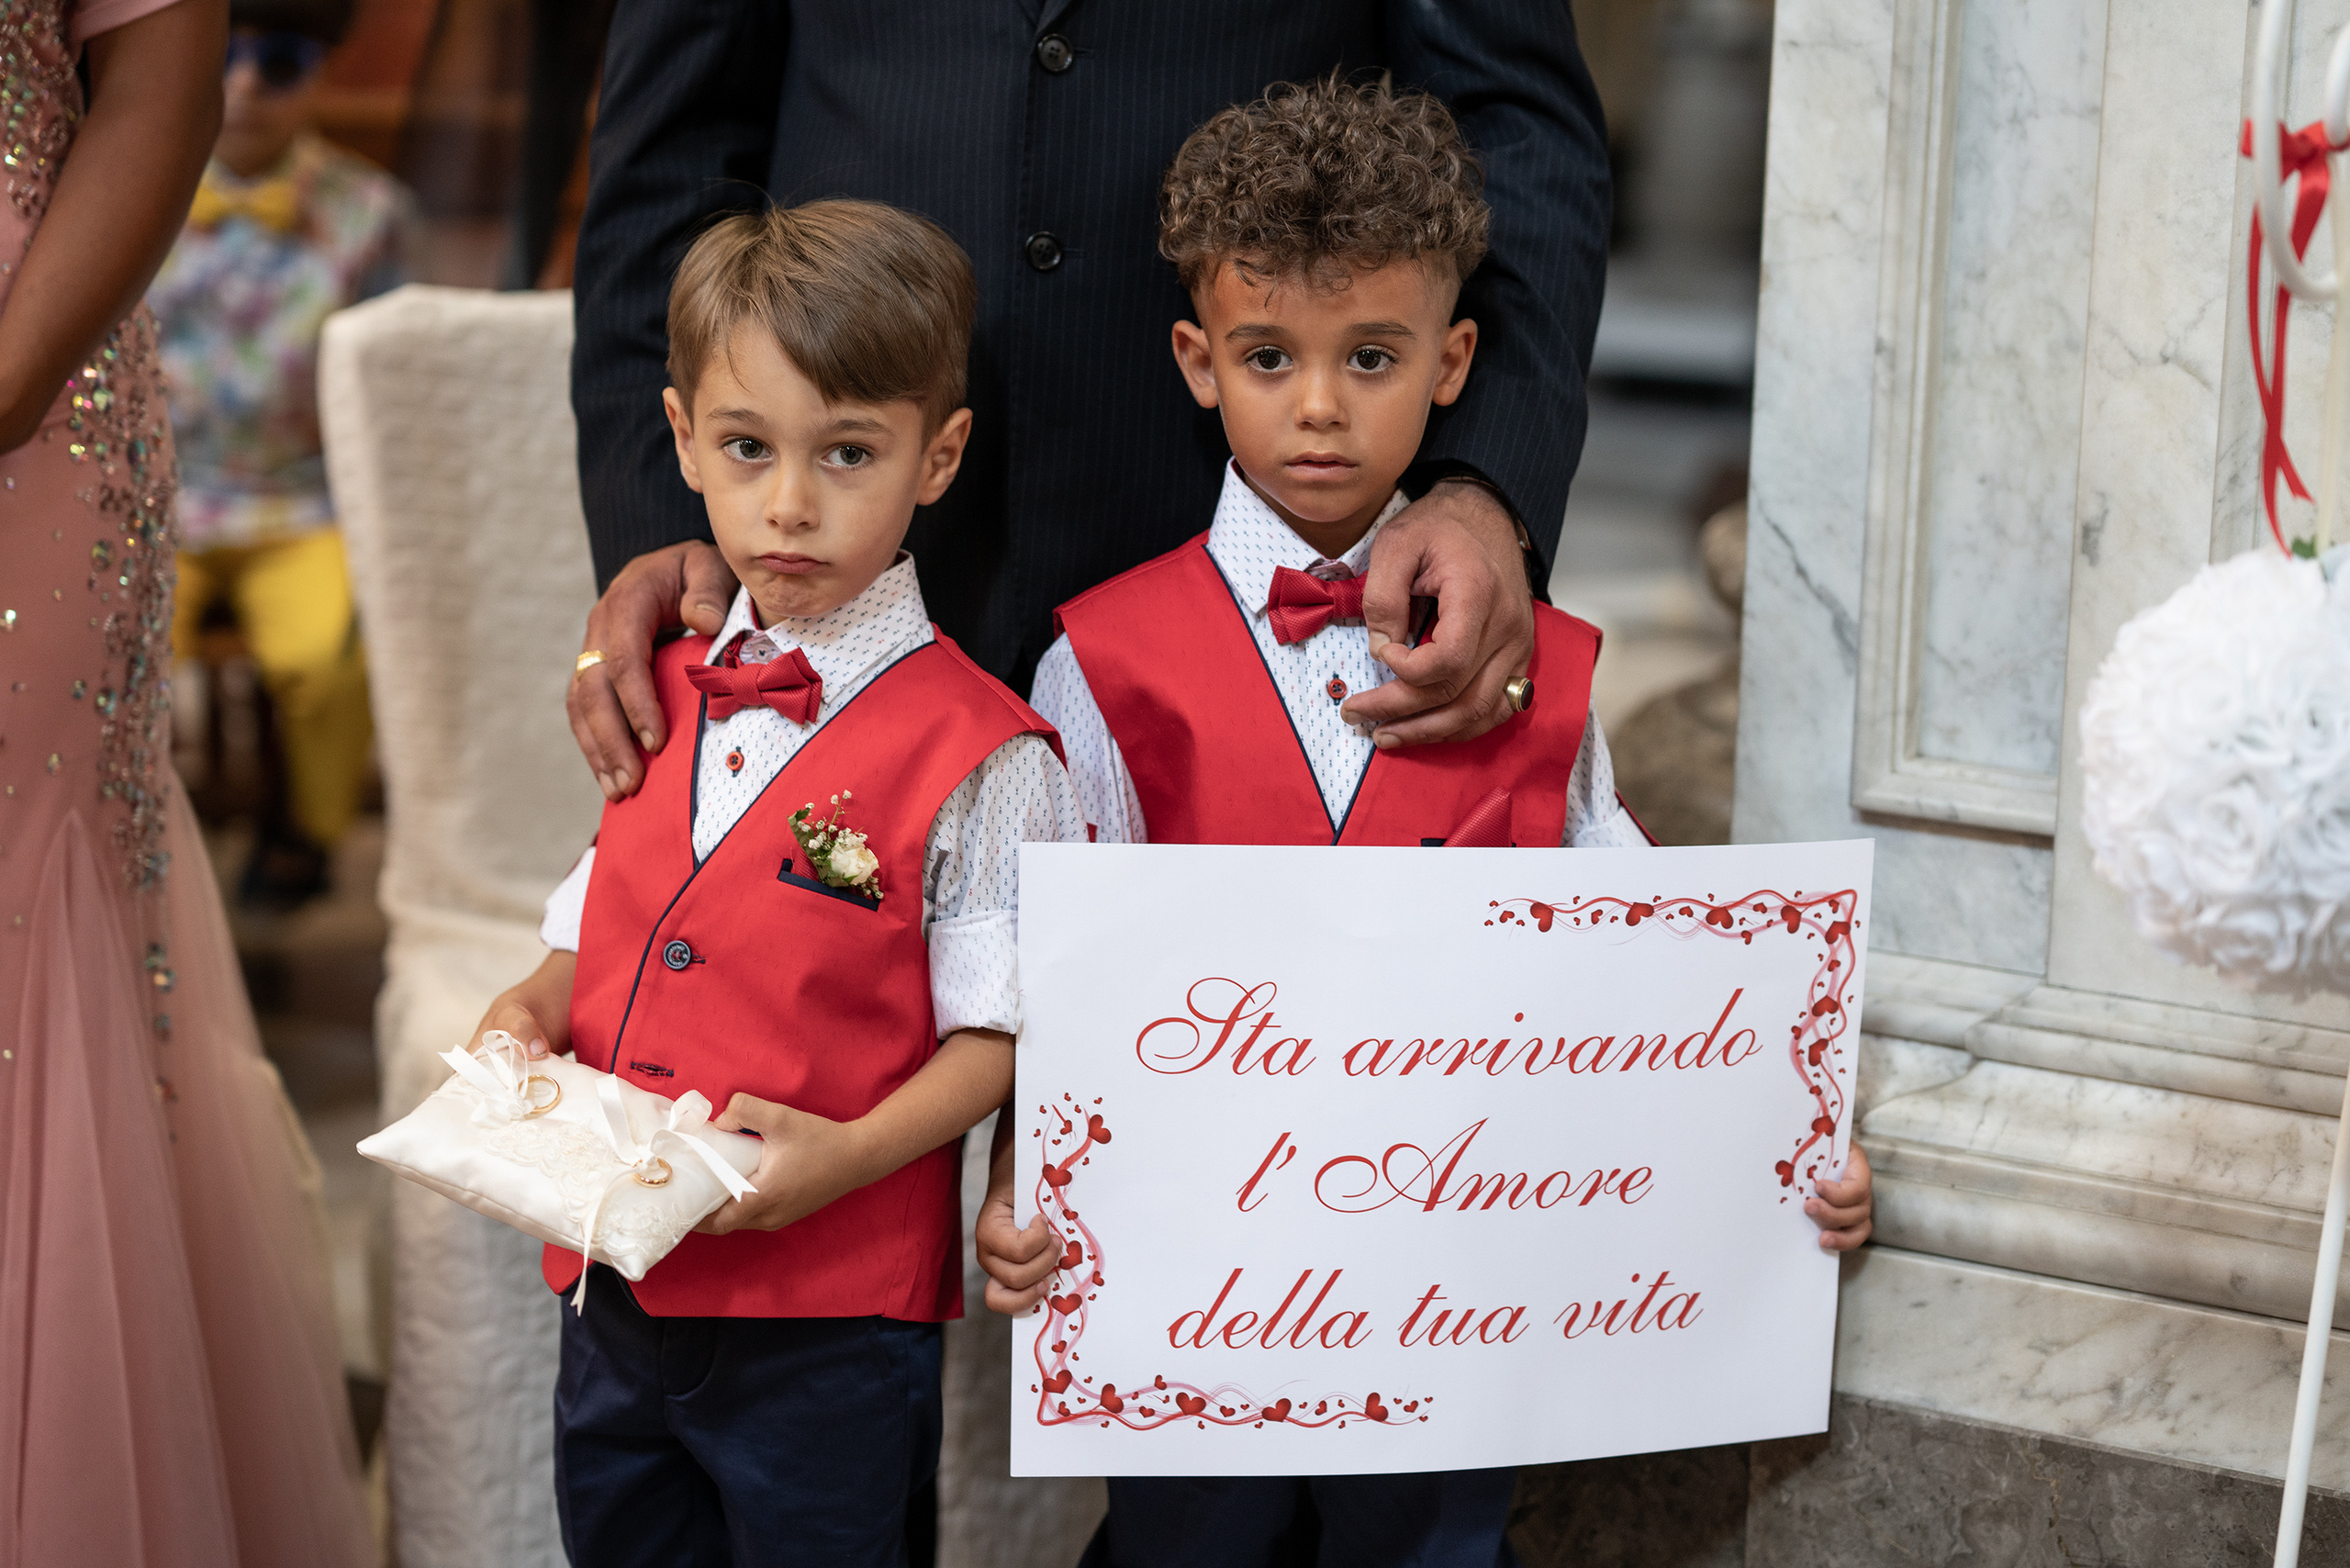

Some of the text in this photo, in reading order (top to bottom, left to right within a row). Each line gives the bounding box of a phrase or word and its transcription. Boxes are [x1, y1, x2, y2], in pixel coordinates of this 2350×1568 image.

[1136, 977, 1763, 1078] Sta arrivando
[1314, 1116, 1654, 1214] Amore
[1167, 1268, 1704, 1350] della tua vita
